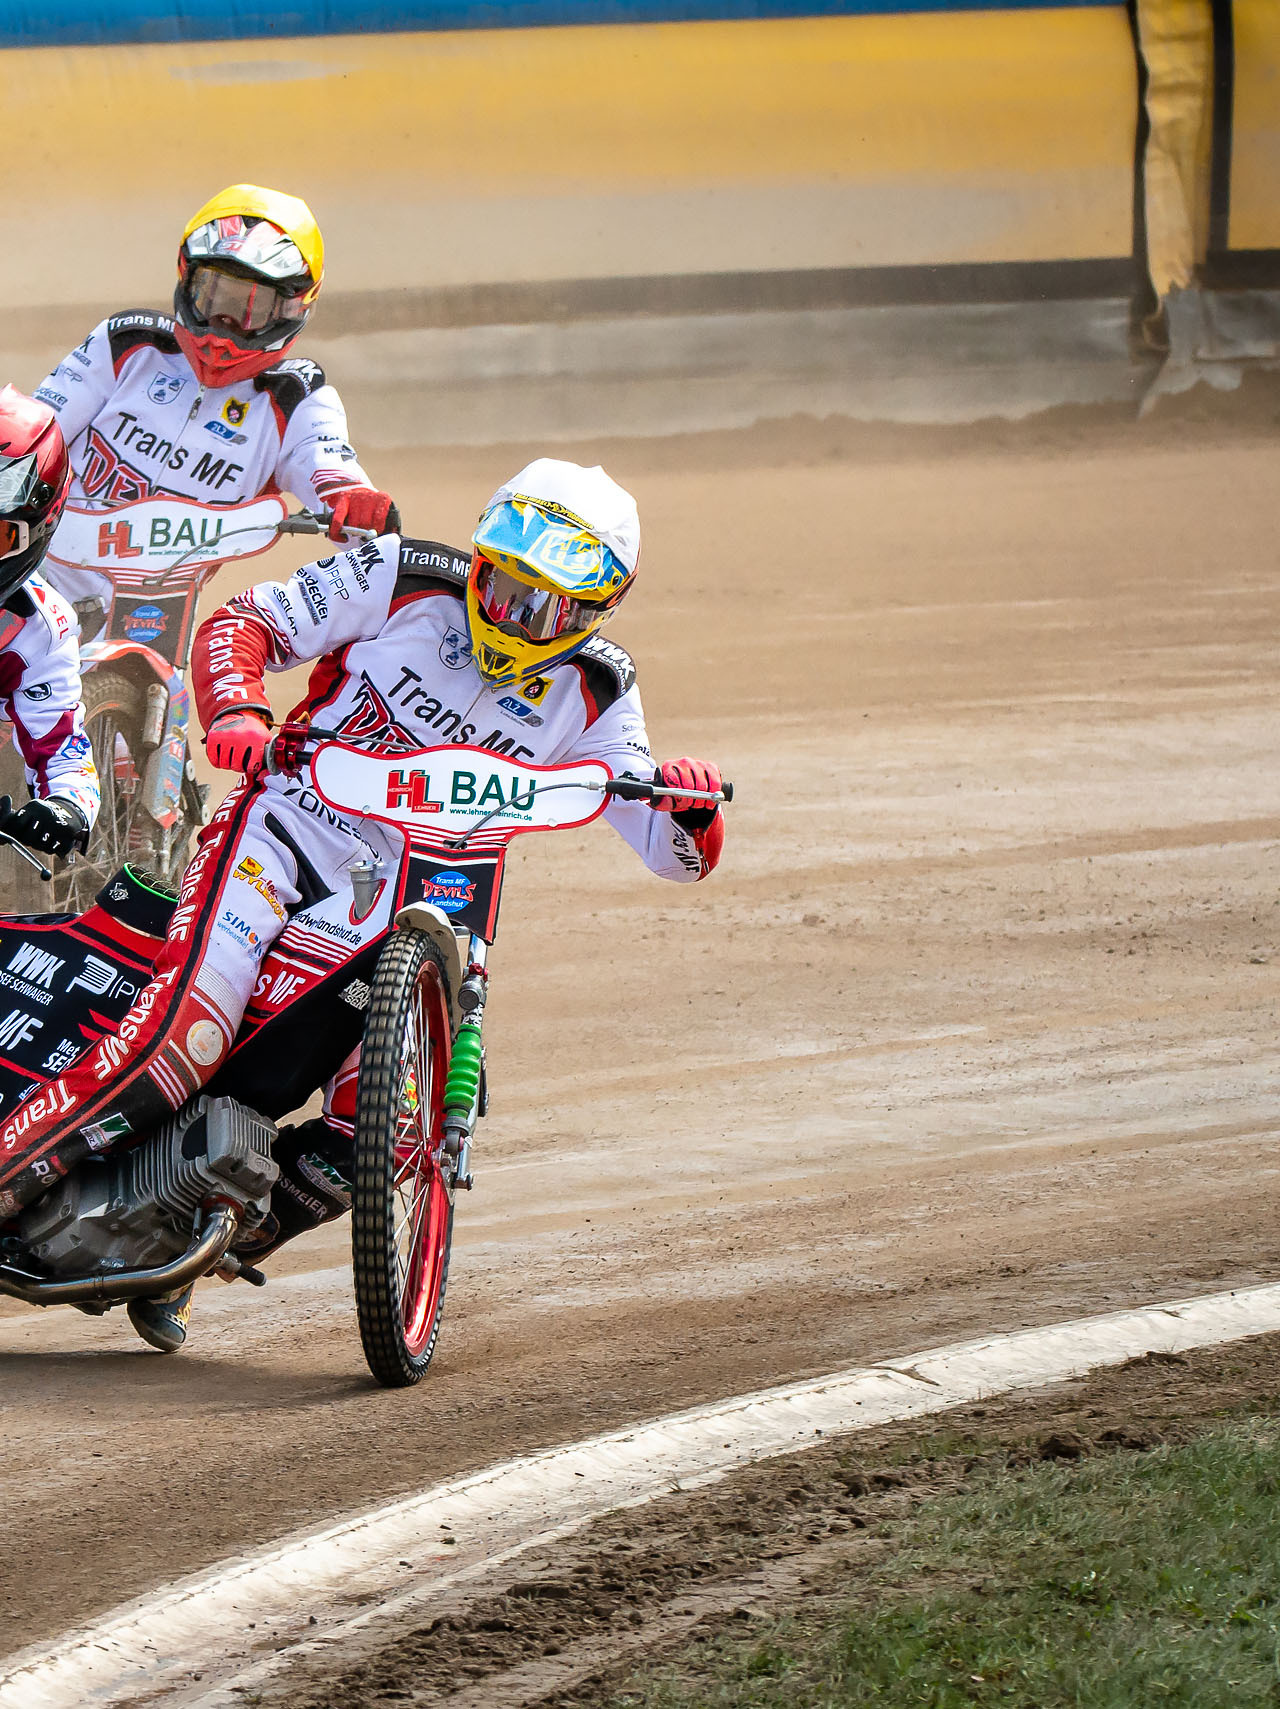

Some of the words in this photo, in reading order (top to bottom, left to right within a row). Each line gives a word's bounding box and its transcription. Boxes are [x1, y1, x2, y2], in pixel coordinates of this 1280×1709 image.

[109, 315, 153, 330] Trans
[113, 412, 188, 470] Trans
[190, 452, 244, 489] MF
[98, 520, 143, 558] HL
[149, 518, 223, 547] BAU
[401, 547, 448, 568] Trans
[49, 604, 69, 640] SEL
[209, 619, 245, 674] Trans
[388, 666, 476, 743] Trans
[386, 769, 444, 813] HL
[450, 770, 536, 811] BAU
[18, 809, 60, 849] FIST
[181, 830, 224, 905] Trans
[421, 879, 477, 902] DEVILS
[430, 899, 463, 908] Landshut
[7, 941, 66, 988] WWK
[9, 976, 54, 1005] SCHWAIGER
[120, 966, 178, 1041] Trans
[4, 1080, 77, 1150] Trans
